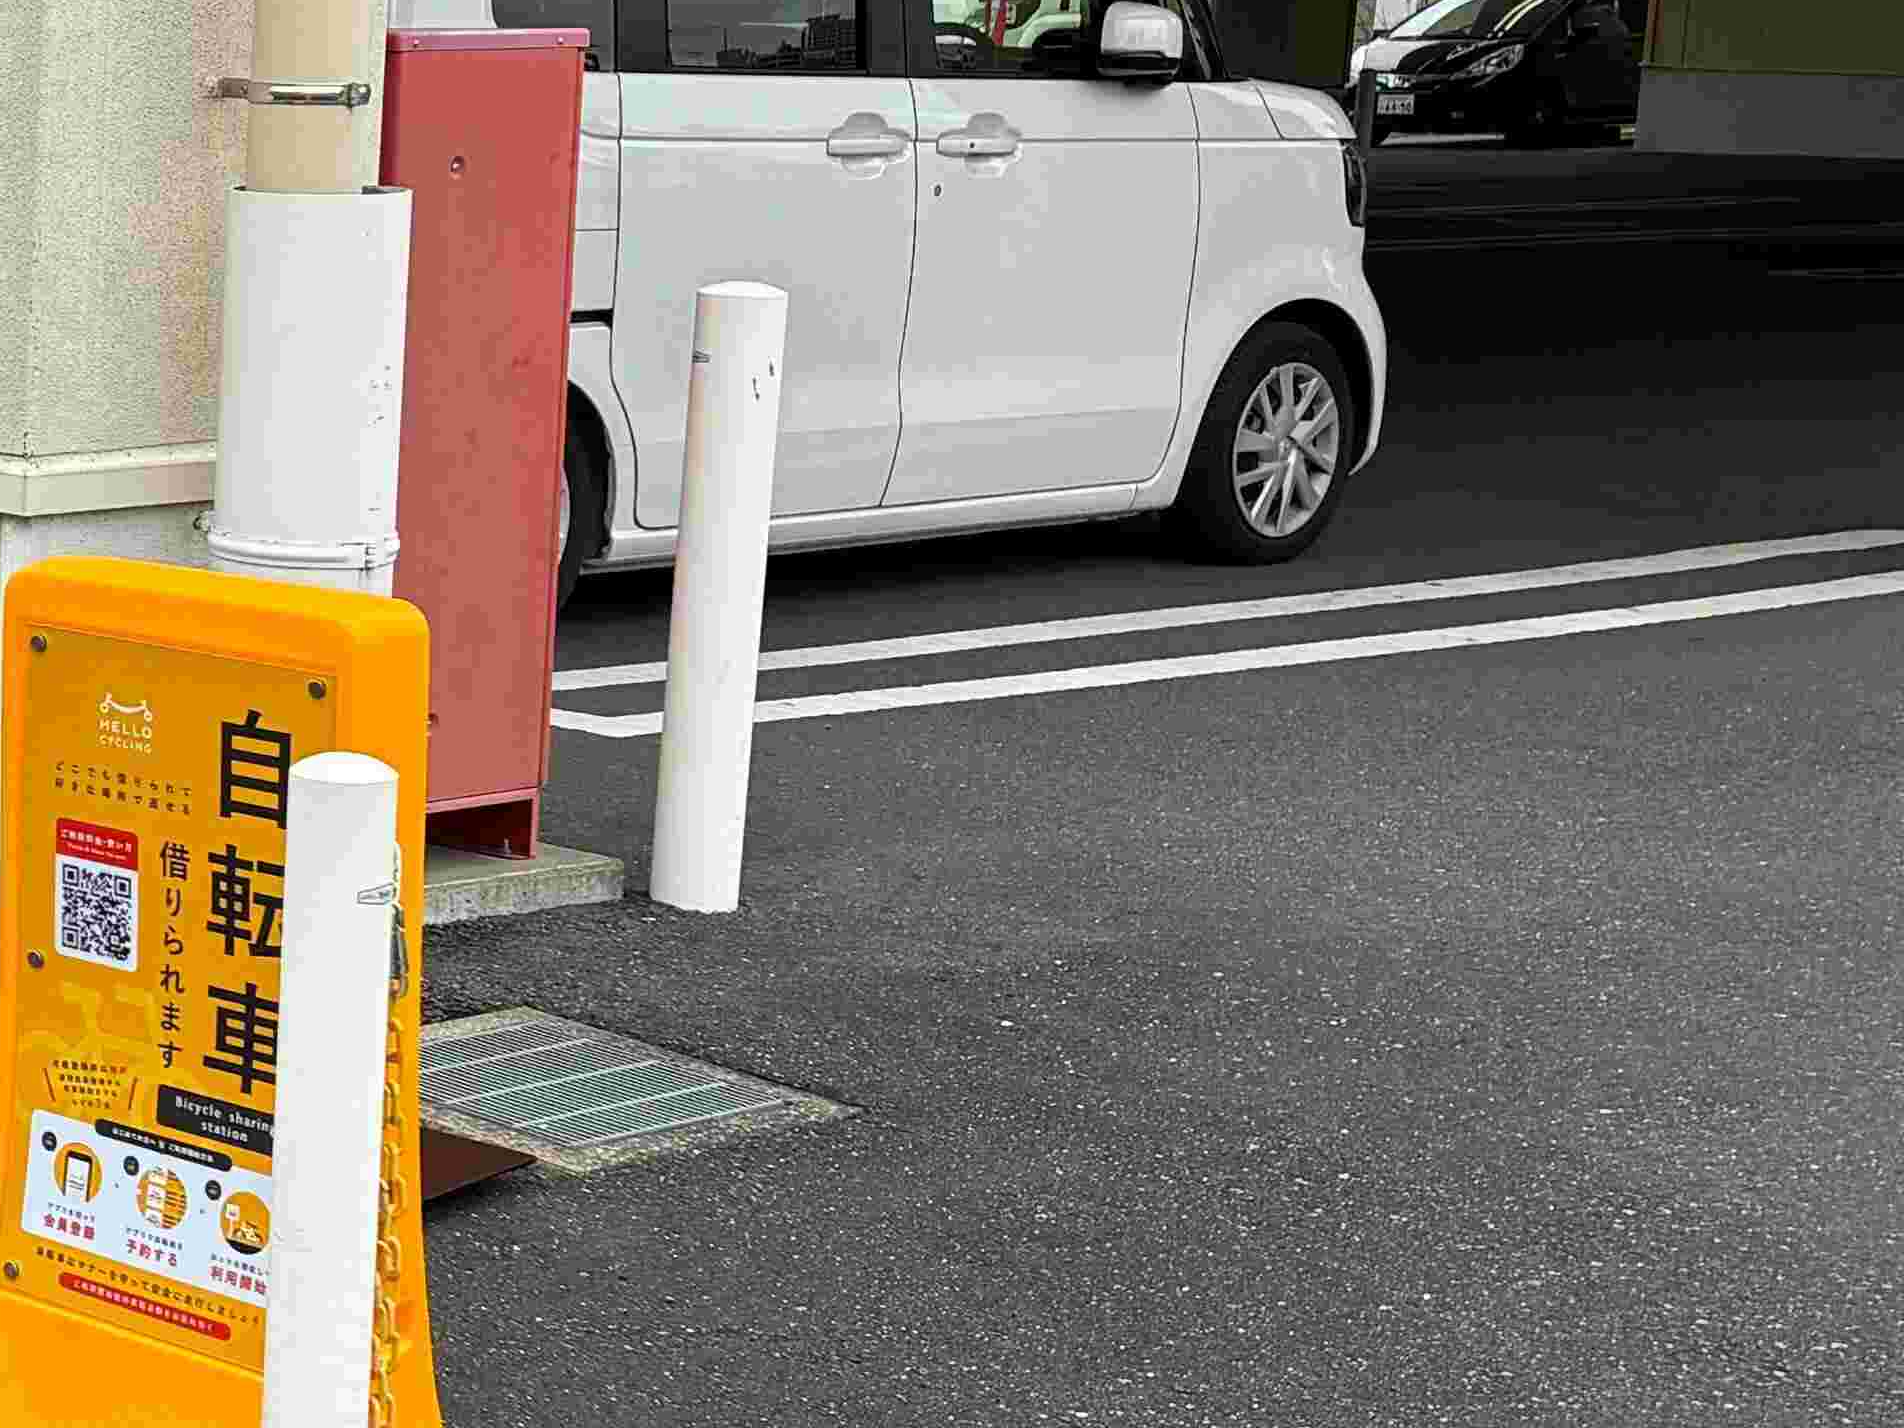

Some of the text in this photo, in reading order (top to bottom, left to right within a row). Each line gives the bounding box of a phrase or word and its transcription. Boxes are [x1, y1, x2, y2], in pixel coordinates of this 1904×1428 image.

[98, 719, 153, 739] HELLO
[98, 735, 153, 755] CYCLING
[203, 708, 292, 1095] 自転車
[158, 840, 191, 1069] 借りられます
[175, 1095, 223, 1119] Bicycle
[200, 1121, 249, 1142] station
[126, 1239, 177, 1267] 予約する
